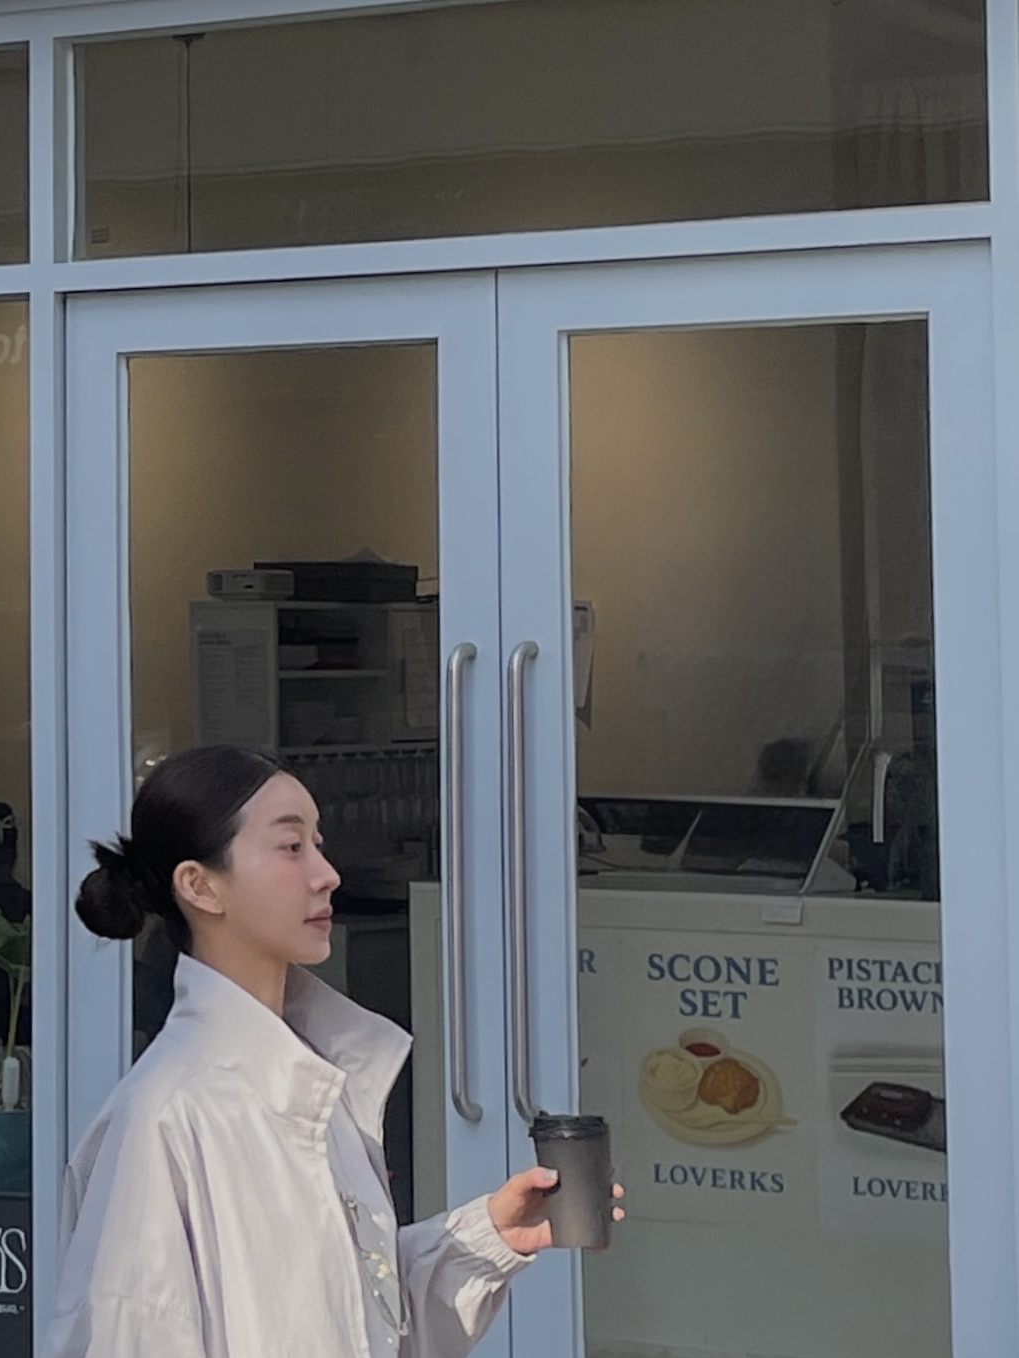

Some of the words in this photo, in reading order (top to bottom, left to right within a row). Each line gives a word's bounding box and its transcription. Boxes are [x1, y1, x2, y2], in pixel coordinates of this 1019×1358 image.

[646, 953, 780, 987] SCONE
[679, 989, 748, 1020] SET
[652, 1163, 785, 1193] LOVERKS
